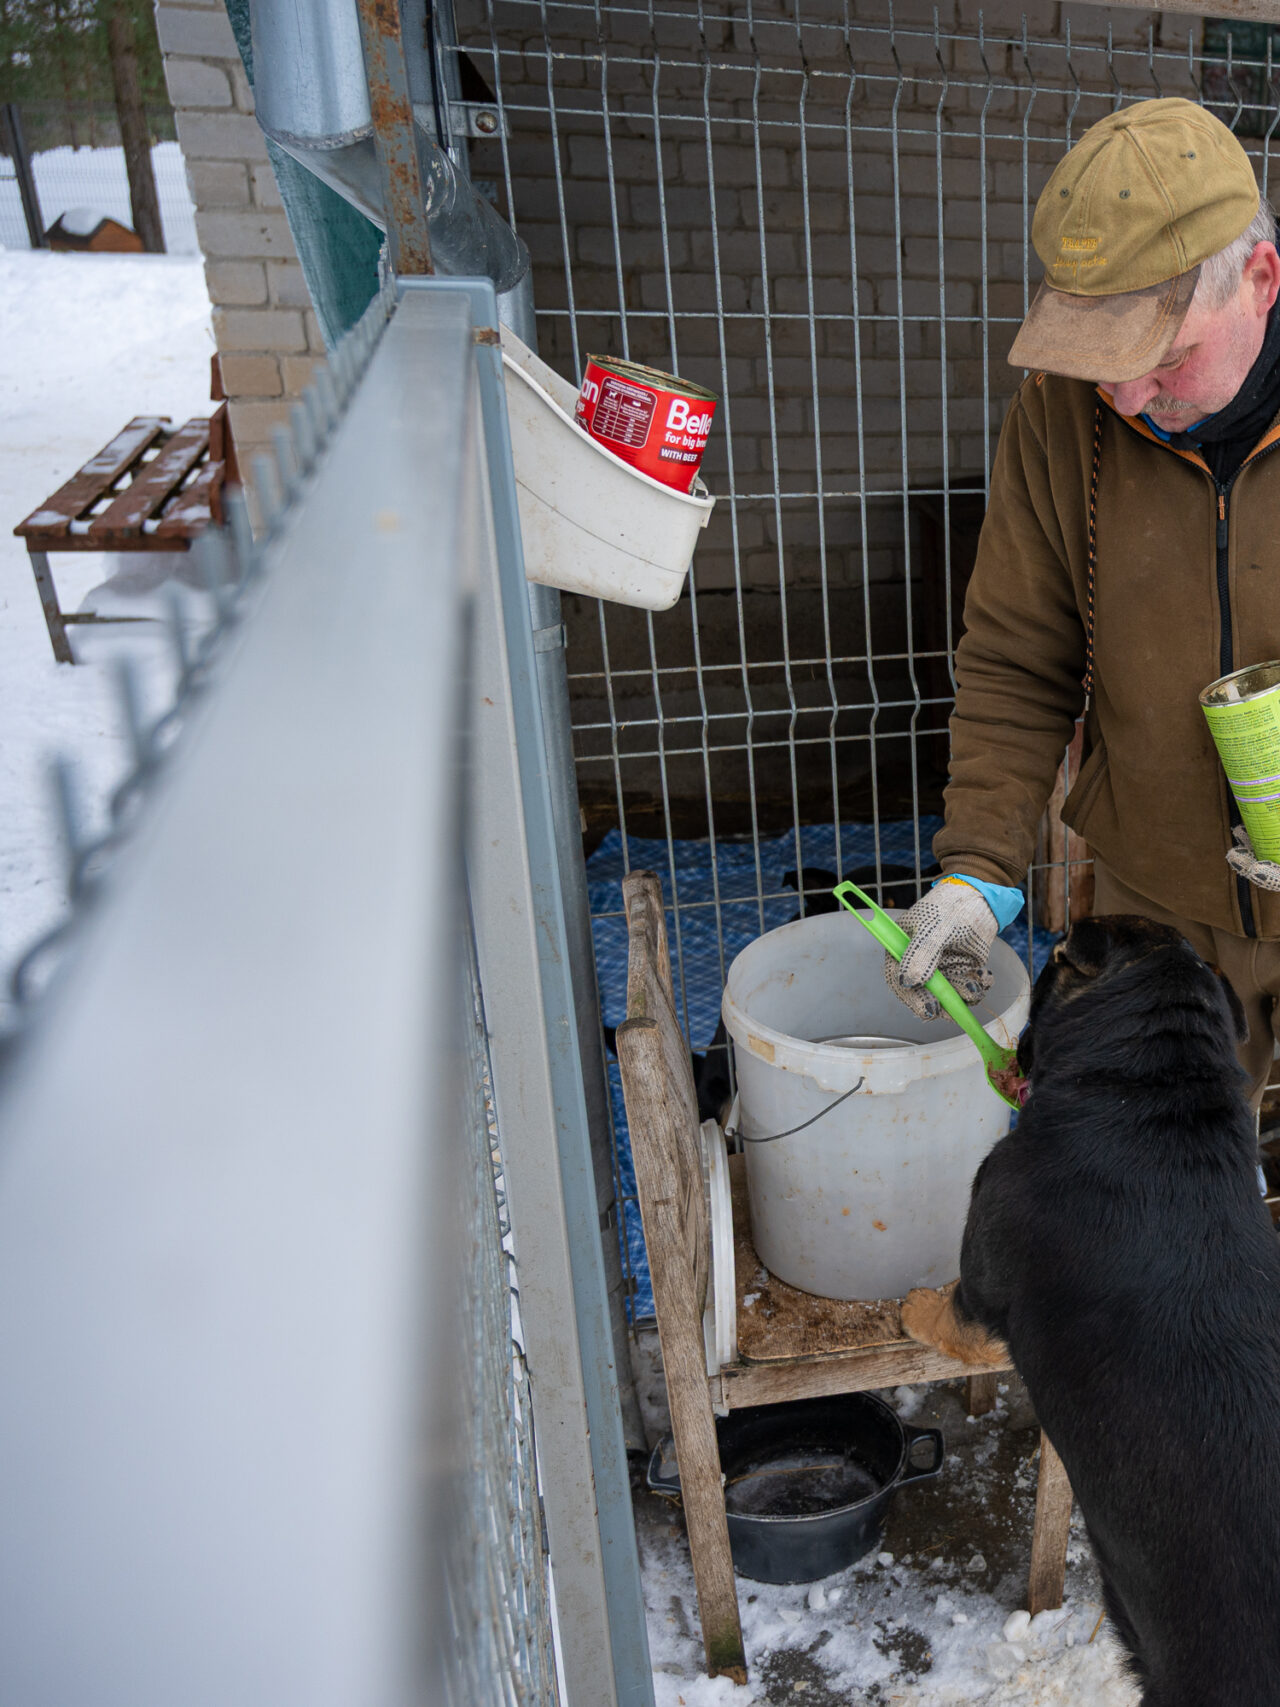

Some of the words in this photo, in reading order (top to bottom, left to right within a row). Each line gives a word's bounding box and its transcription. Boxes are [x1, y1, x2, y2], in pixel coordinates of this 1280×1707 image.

[665, 431, 682, 443] for
[683, 435, 696, 449] big
[661, 448, 682, 460] WITH
[682, 453, 698, 462] BEEF
